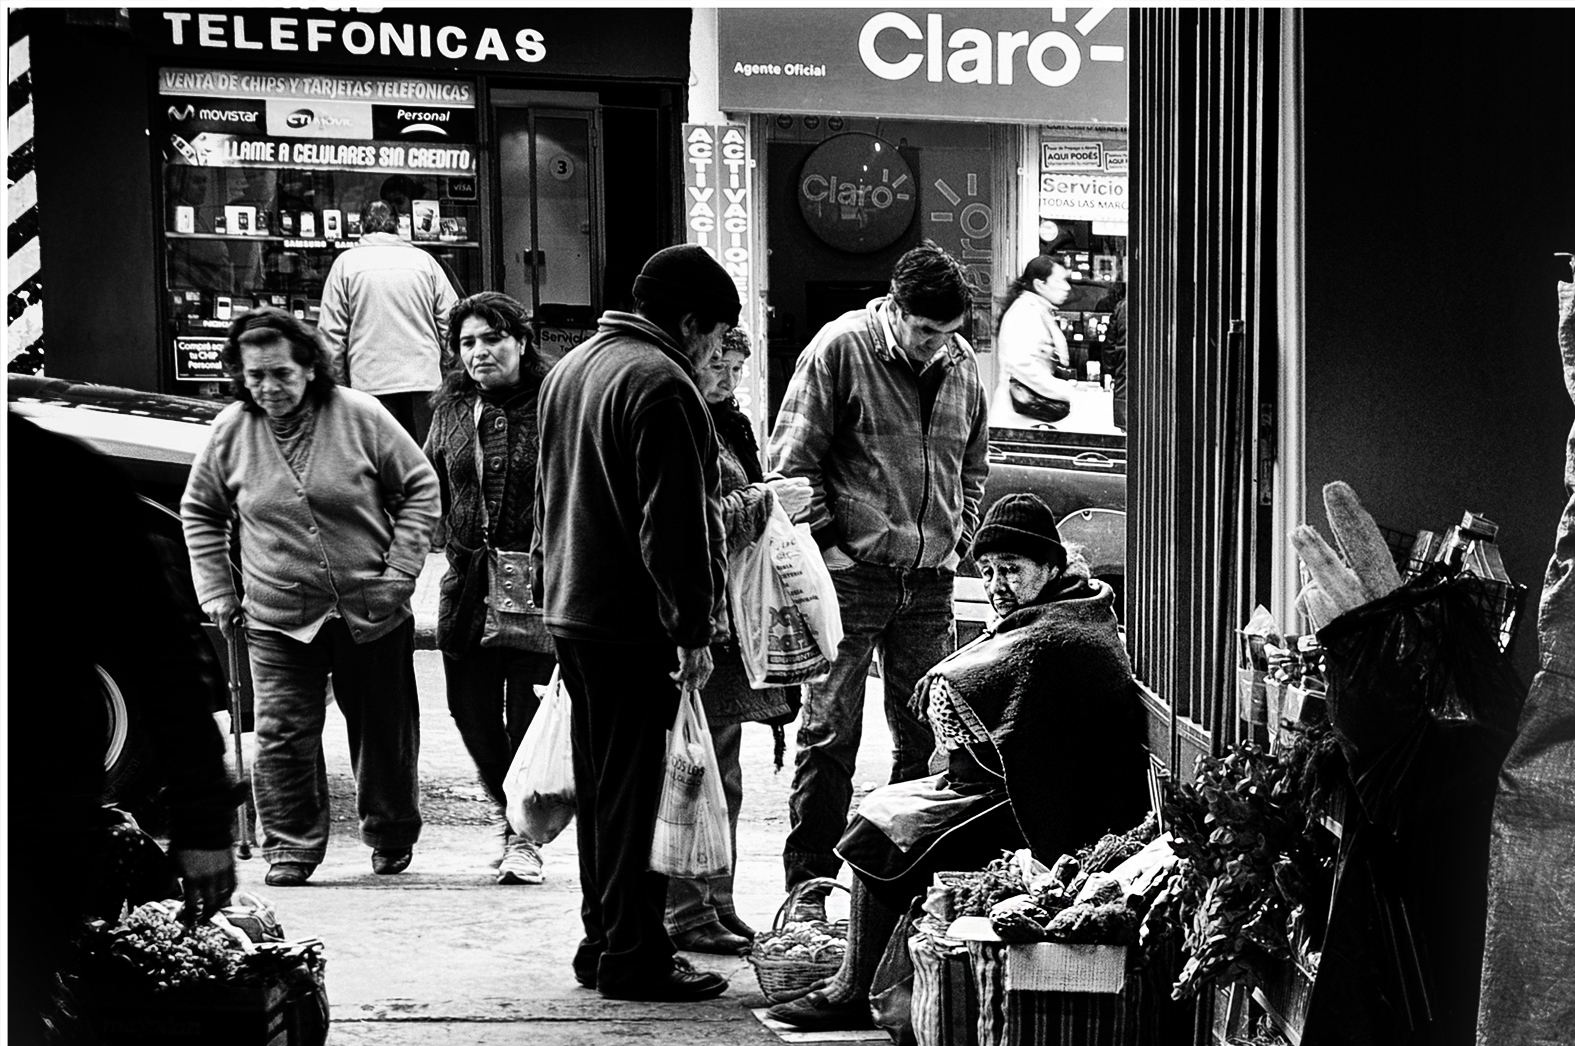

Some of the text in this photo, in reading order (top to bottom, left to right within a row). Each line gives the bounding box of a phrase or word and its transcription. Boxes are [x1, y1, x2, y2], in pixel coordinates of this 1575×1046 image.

[163, 12, 547, 63] TELEFONICAS
[858, 11, 1081, 87] Claro
[734, 61, 826, 76] Agente Oficial
[165, 72, 470, 101] VENTA DE CHIPS Y TARJETAS TELEFONICAS
[397, 109, 451, 122] Personal
[223, 140, 276, 162] LLAME
[278, 142, 290, 162] A
[293, 143, 376, 166] CELULARES
[407, 148, 471, 169] CREDITO
[1047, 152, 1069, 160] AQUI
[1070, 151, 1098, 160] PODÉS
[556, 160, 568, 175] 3
[453, 181, 472, 192] VISA
[687, 127, 715, 250] ACTIVACI
[803, 174, 893, 209] Claro
[1042, 177, 1124, 196] Servicio
[1042, 198, 1128, 210] TODAS LAS MARC
